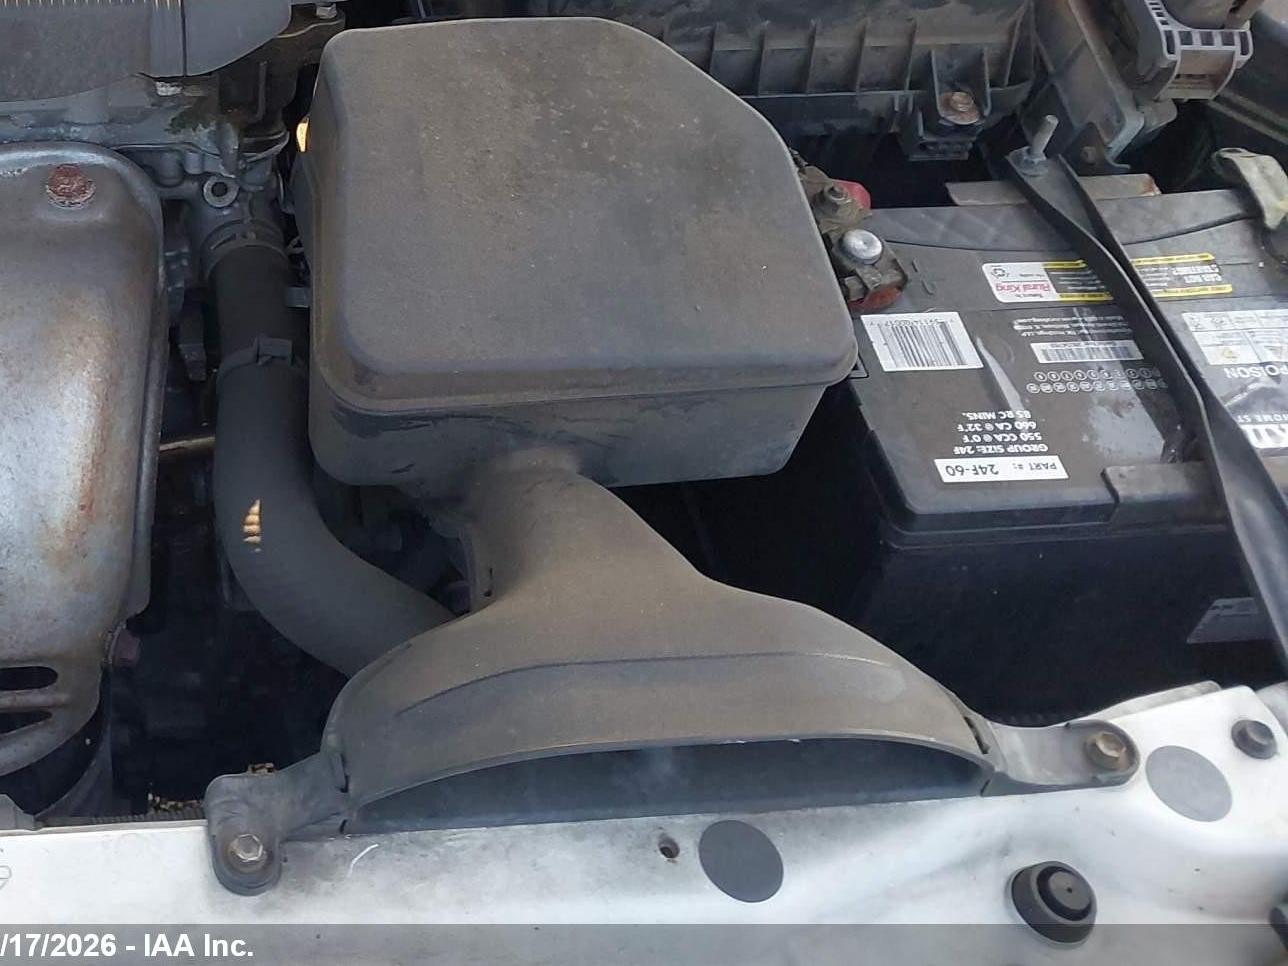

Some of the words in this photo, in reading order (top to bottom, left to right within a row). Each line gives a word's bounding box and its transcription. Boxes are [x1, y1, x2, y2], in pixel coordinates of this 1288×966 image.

[1224, 364, 1288, 379] POISON
[962, 411, 996, 421] MINS.
[998, 411, 1014, 419] RC
[984, 423, 995, 431] @
[995, 422, 1012, 431] CA
[1014, 421, 1037, 430] 660
[983, 434, 993, 443] @
[993, 433, 1018, 442] CCA
[1019, 432, 1042, 441] 550
[952, 445, 975, 455] 24F
[976, 444, 1005, 454] SIZE:
[1007, 443, 1049, 452] GROUP
[945, 464, 999, 477] 24F-60
[1028, 462, 1057, 471] PART
